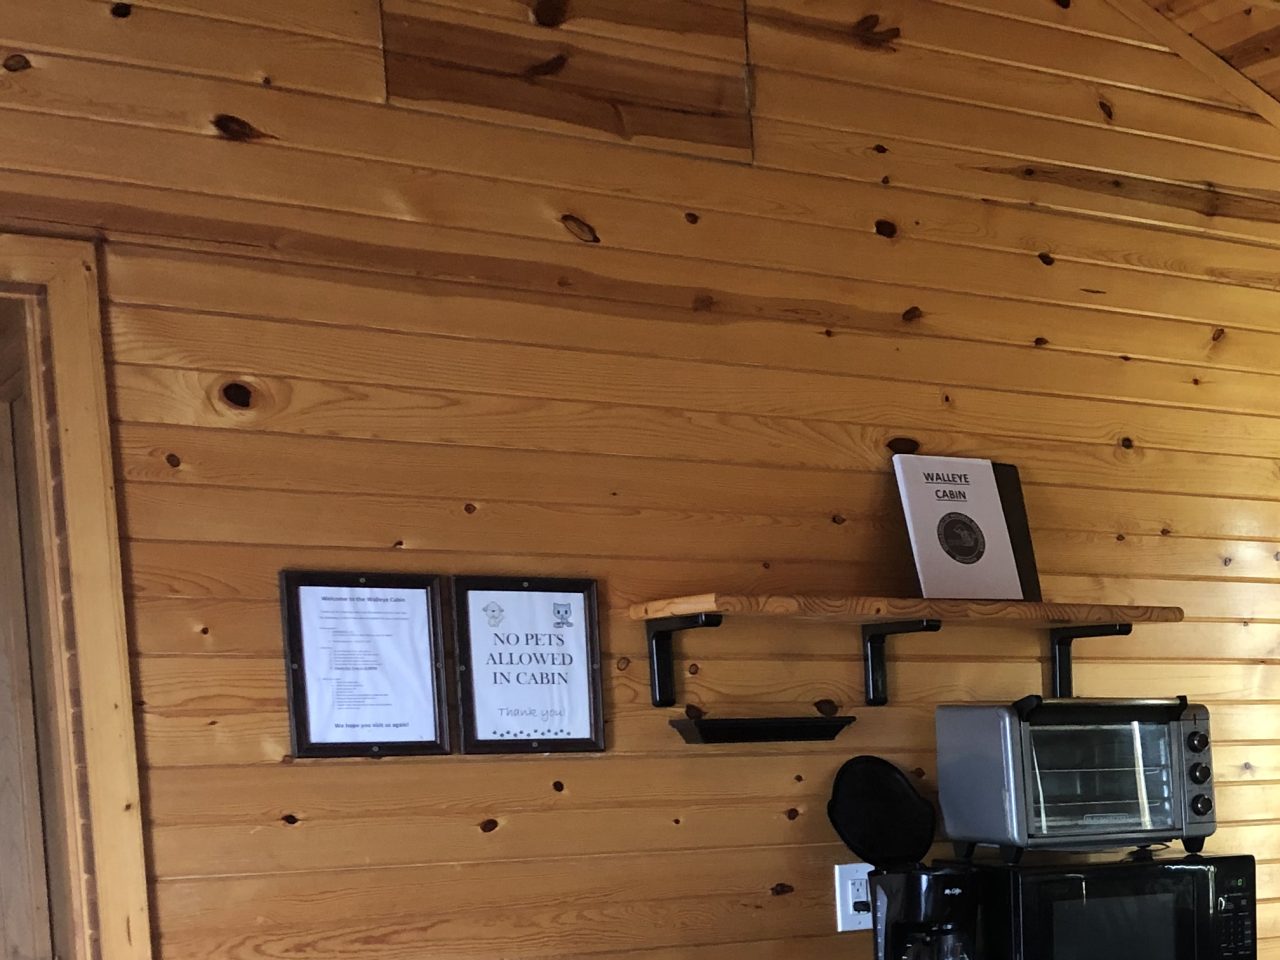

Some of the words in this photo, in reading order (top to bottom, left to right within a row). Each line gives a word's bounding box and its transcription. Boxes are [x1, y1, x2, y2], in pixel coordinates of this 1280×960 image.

[922, 472, 970, 484] WALLEYE
[934, 489, 967, 500] CABIN
[493, 632, 520, 646] NO
[524, 632, 565, 647] PETS
[486, 652, 574, 666] ALLOWED
[492, 671, 511, 685] IN
[516, 671, 569, 685] CABIN
[497, 707, 538, 718] Thank
